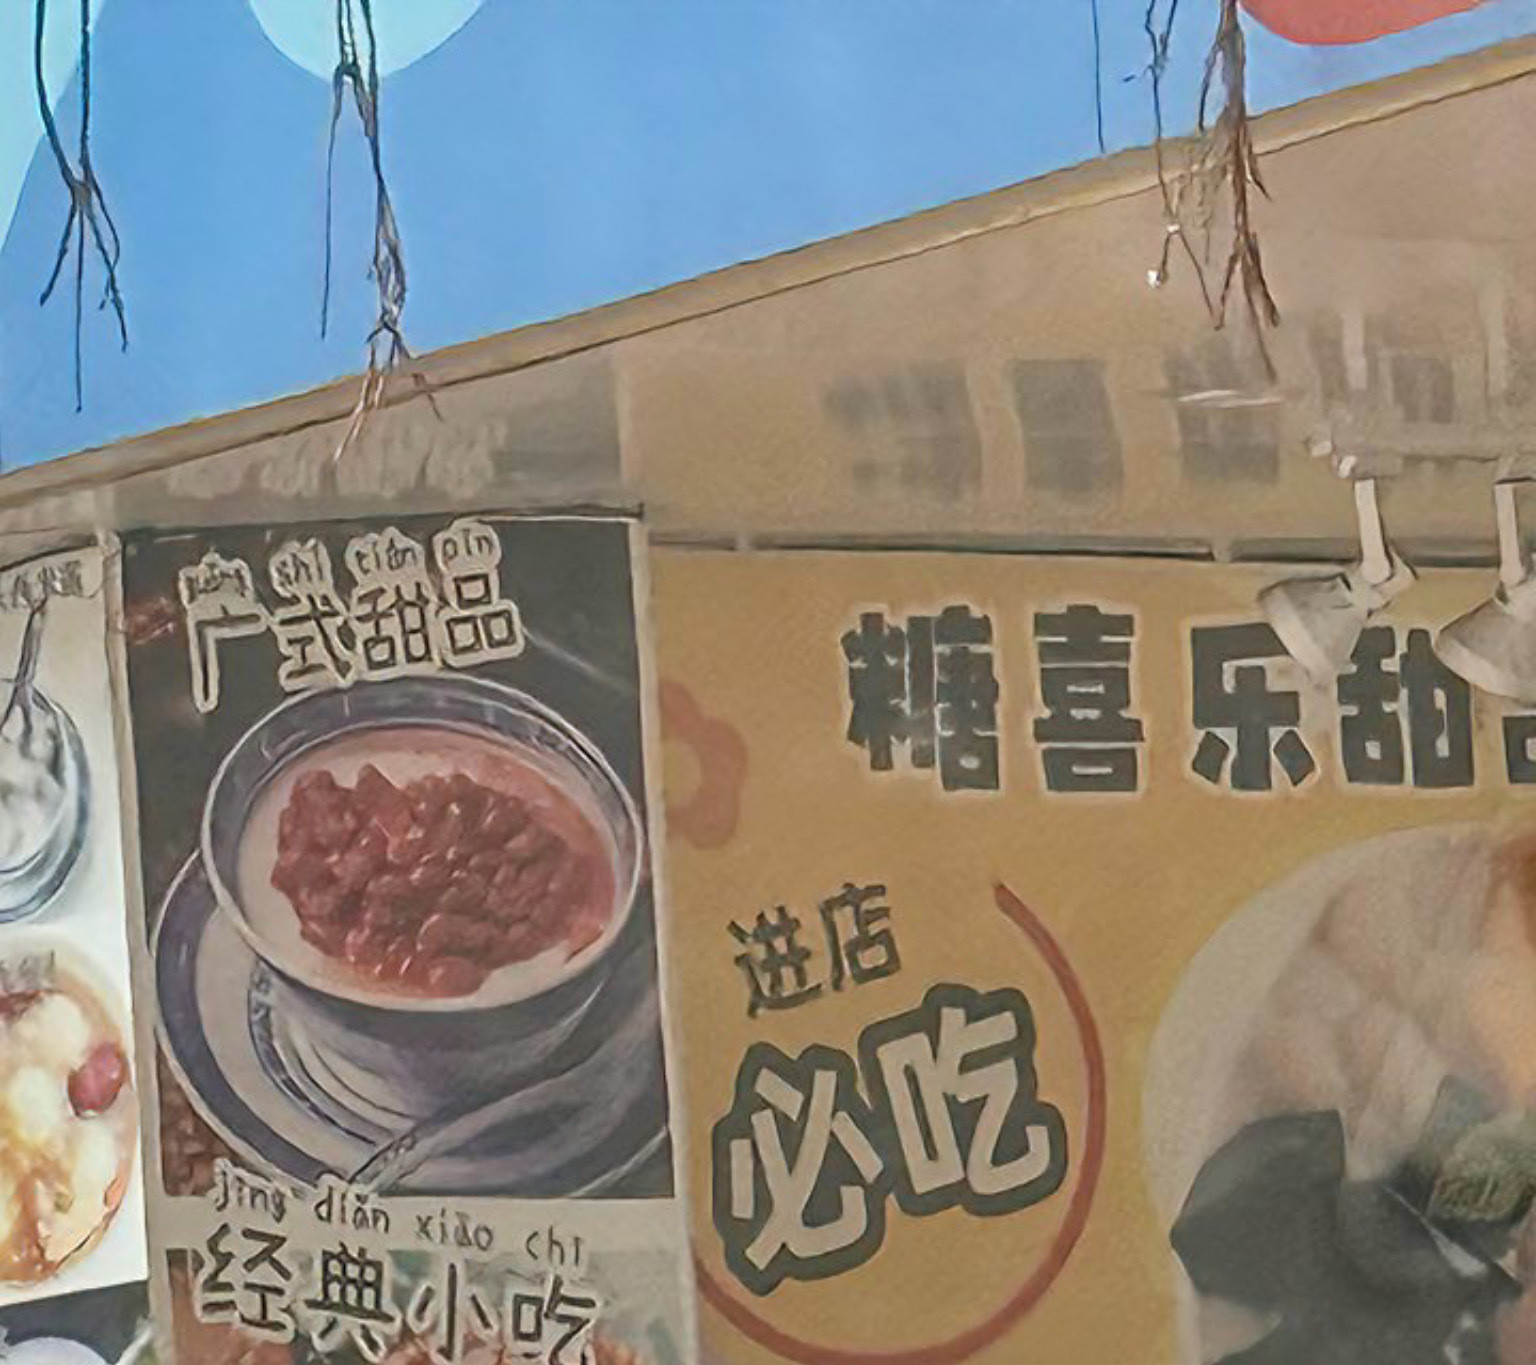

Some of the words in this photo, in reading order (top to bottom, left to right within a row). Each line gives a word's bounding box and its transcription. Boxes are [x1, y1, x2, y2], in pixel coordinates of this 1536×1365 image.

[191, 572, 524, 712] 广式甜品
[841, 603, 1536, 794] 糖喜乐甜
[726, 881, 902, 1017] 进店
[716, 988, 1064, 1290] 必吃
